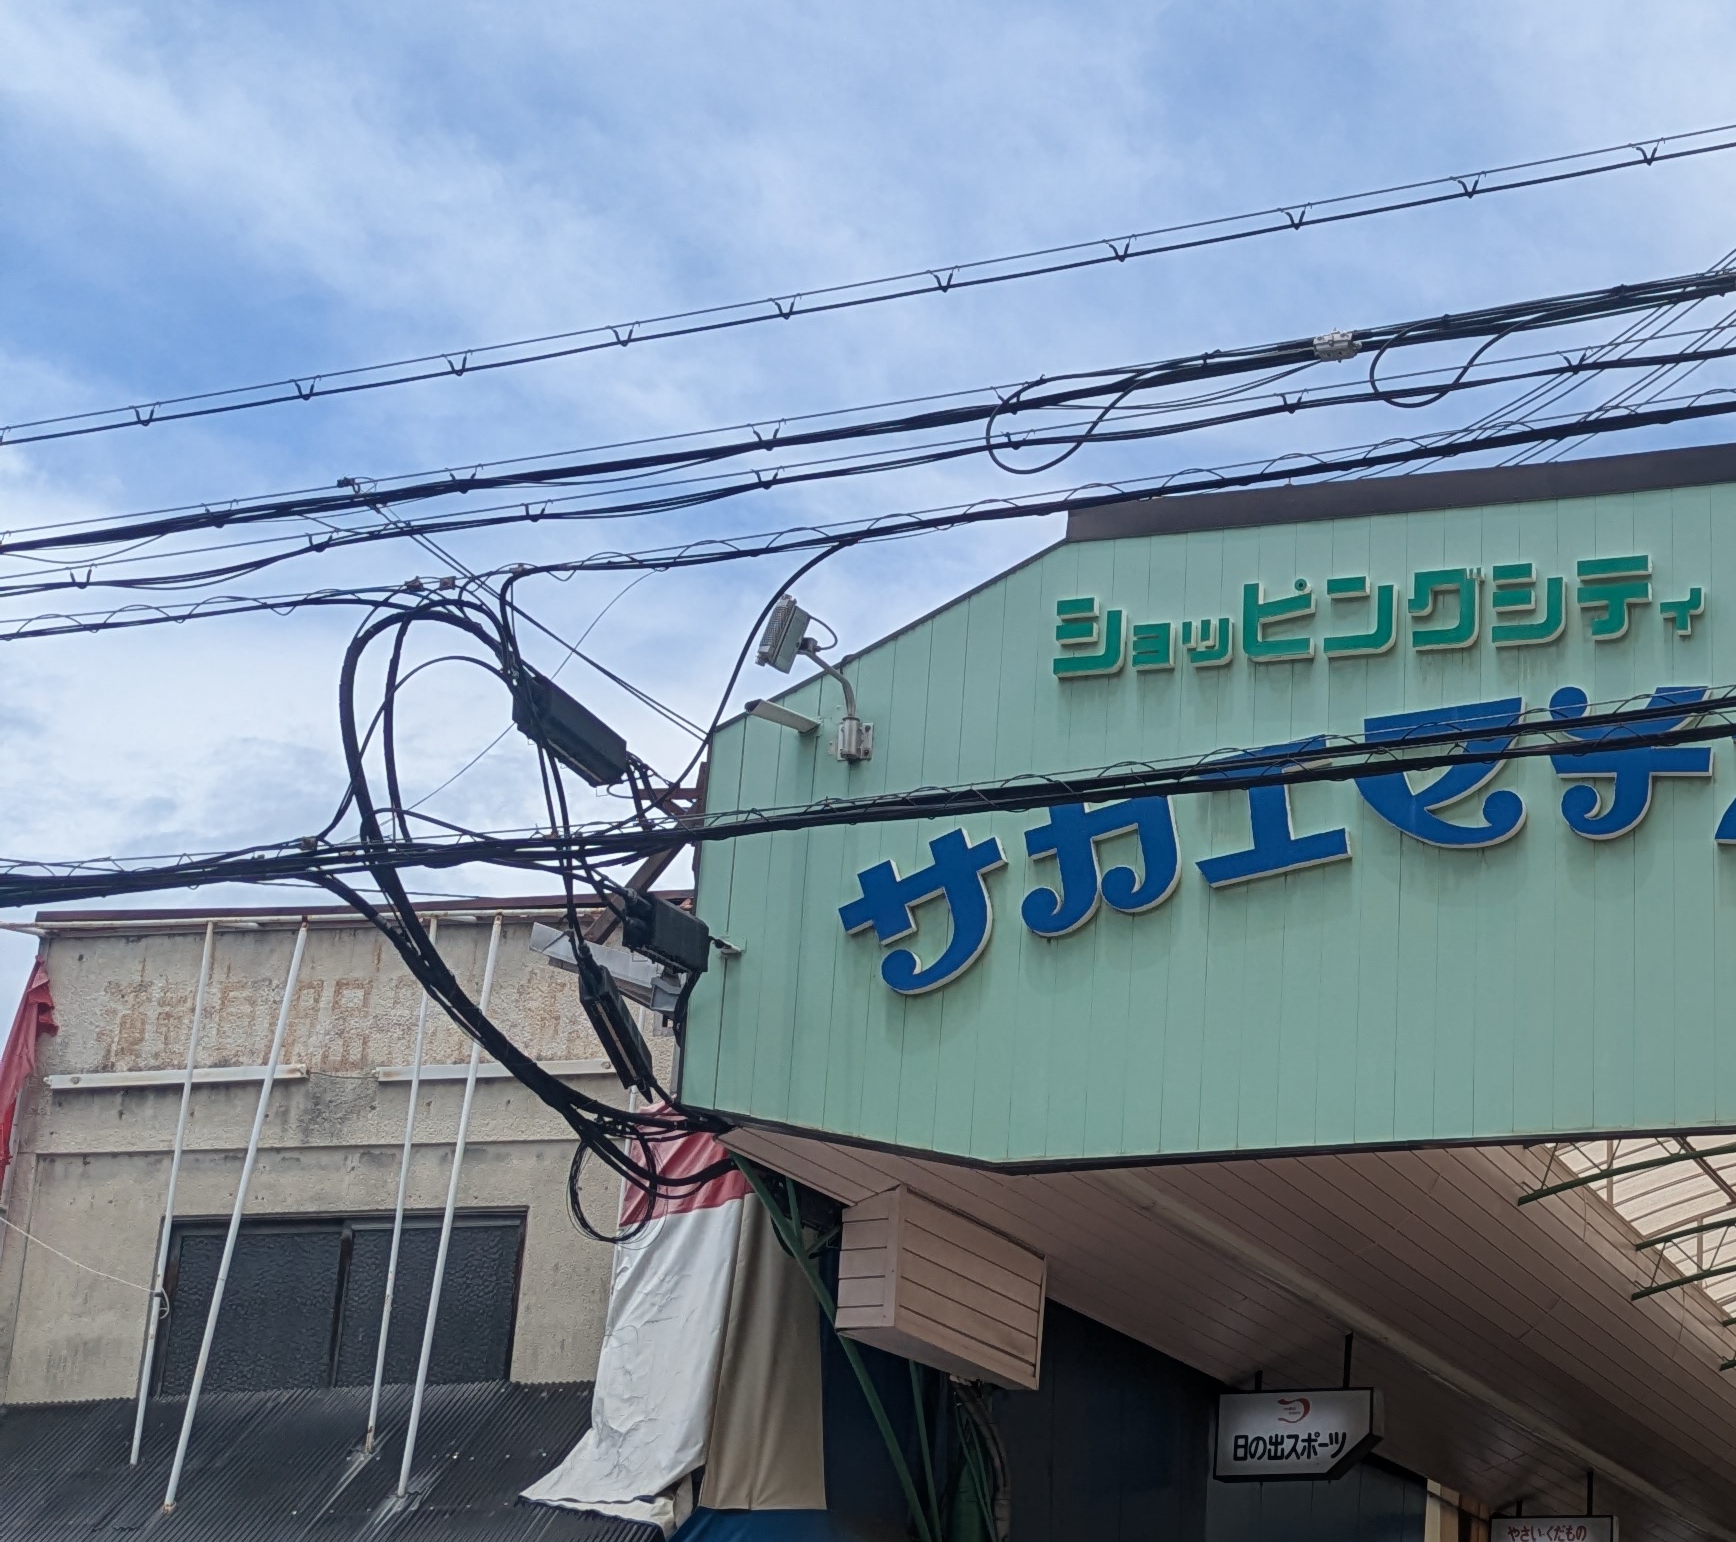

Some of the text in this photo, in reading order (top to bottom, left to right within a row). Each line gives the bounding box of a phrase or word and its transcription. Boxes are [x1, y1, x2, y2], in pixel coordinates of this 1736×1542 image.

[1052, 553, 1706, 680] ショッピングシティ
[1232, 1430, 1347, 1462] 日の出スポーツ
